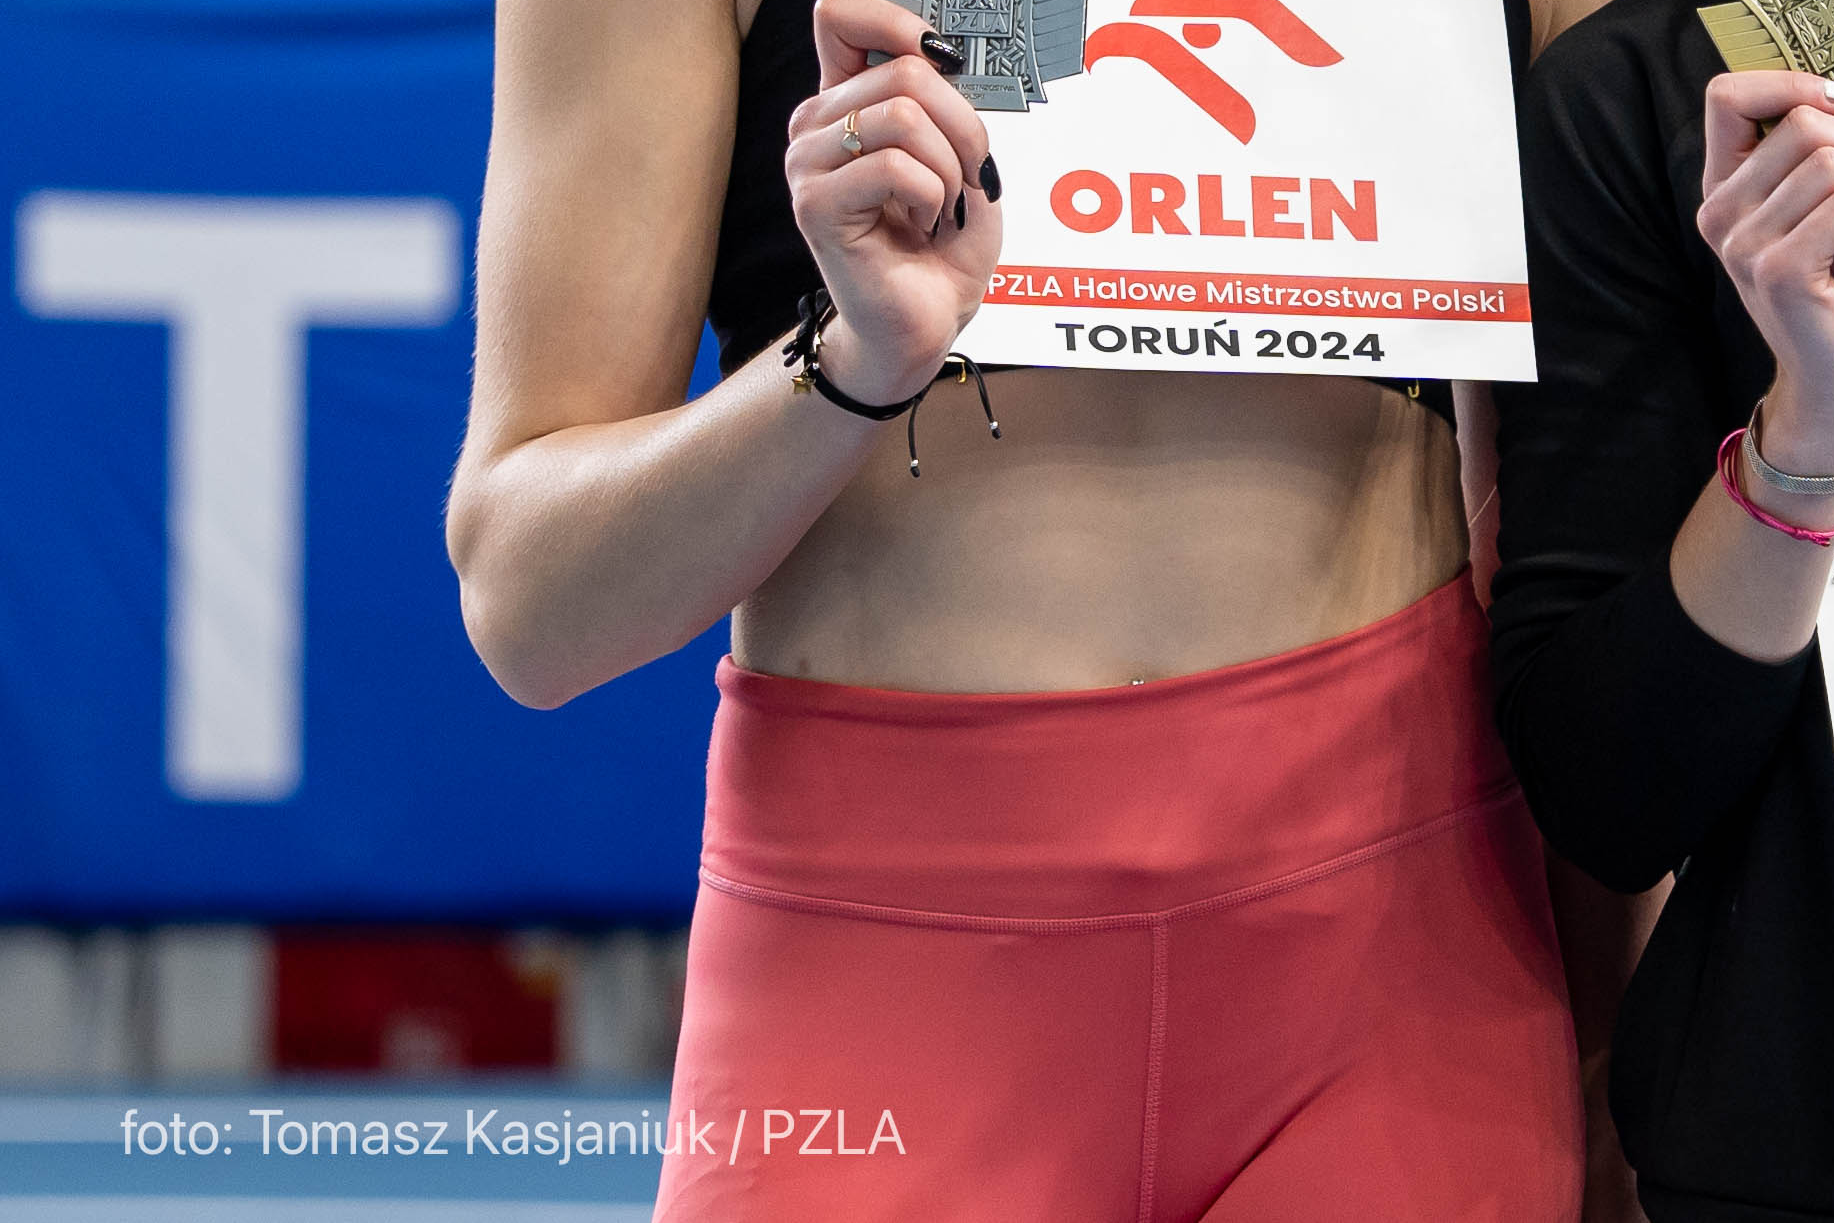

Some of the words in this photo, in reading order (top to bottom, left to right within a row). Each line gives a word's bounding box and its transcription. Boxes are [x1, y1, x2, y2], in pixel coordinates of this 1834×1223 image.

[949, 11, 1007, 33] PZLA
[1050, 169, 1379, 242] ORLEN
[988, 273, 1063, 299] PZLA
[1073, 276, 1198, 303] Halowe
[1207, 280, 1403, 311] Mistrzostwa
[1413, 288, 1507, 315] Polski
[1055, 318, 1240, 357] TORUŃ
[1255, 329, 1385, 362] 2024
